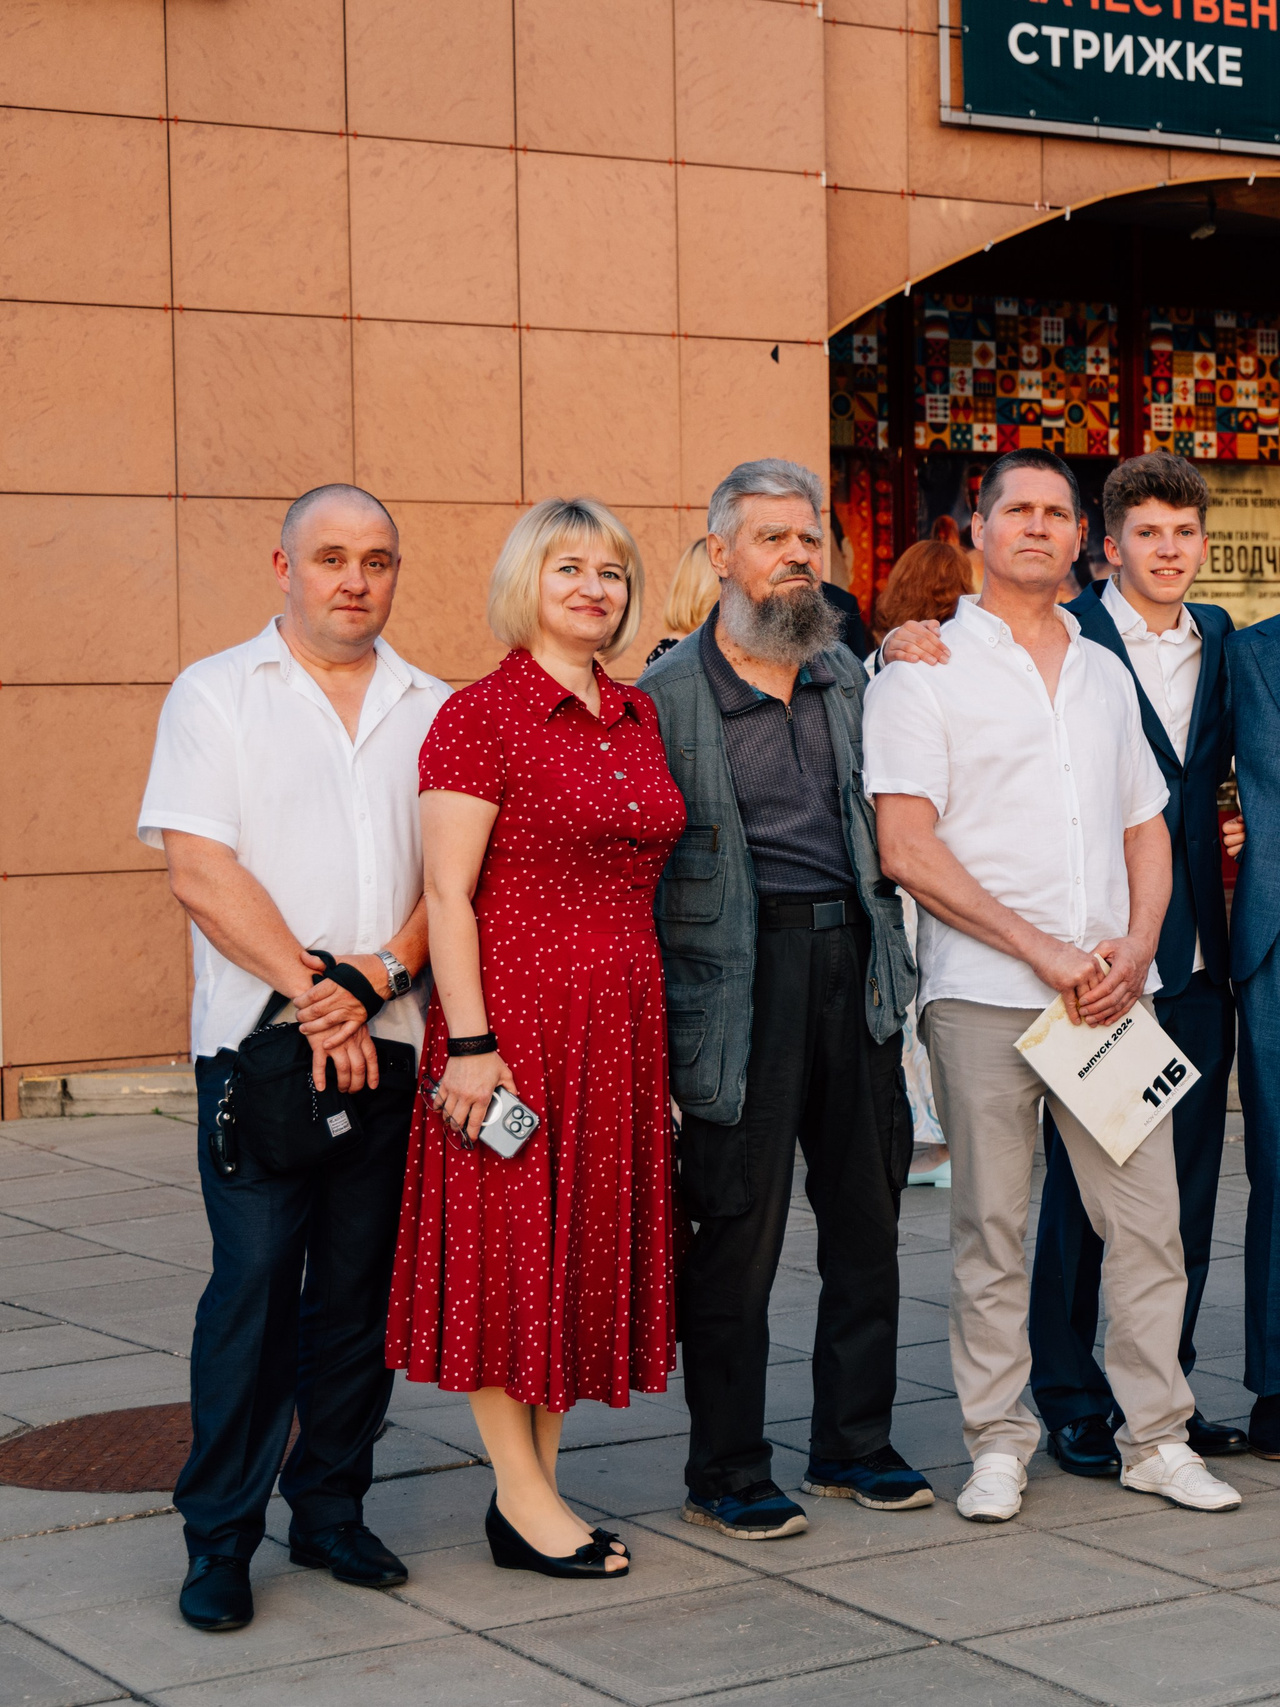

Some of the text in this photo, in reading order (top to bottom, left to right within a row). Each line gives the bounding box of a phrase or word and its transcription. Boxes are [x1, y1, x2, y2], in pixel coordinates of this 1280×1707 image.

[1008, 22, 1243, 87] СТРИЖКЕ
[1077, 1017, 1133, 1079] ВЫПУСК 2024
[1142, 1057, 1187, 1108] 11Б
